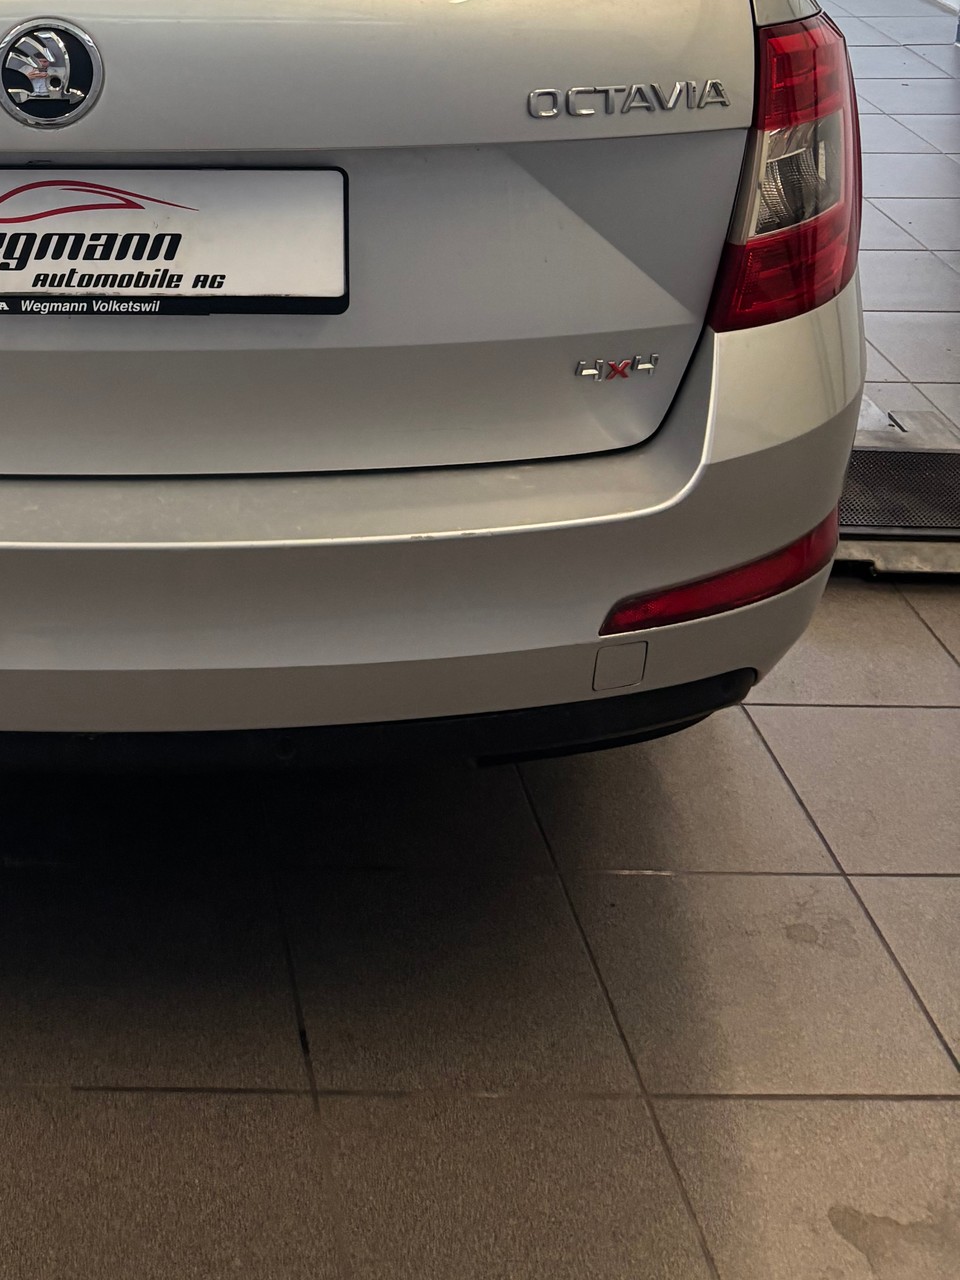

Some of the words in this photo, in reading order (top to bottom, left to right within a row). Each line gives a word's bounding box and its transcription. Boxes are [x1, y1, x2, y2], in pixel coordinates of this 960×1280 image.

[527, 79, 730, 119] OCTAVIA
[191, 274, 226, 289] AG
[20, 299, 87, 315] Wegmann
[92, 299, 160, 313] Volketswil
